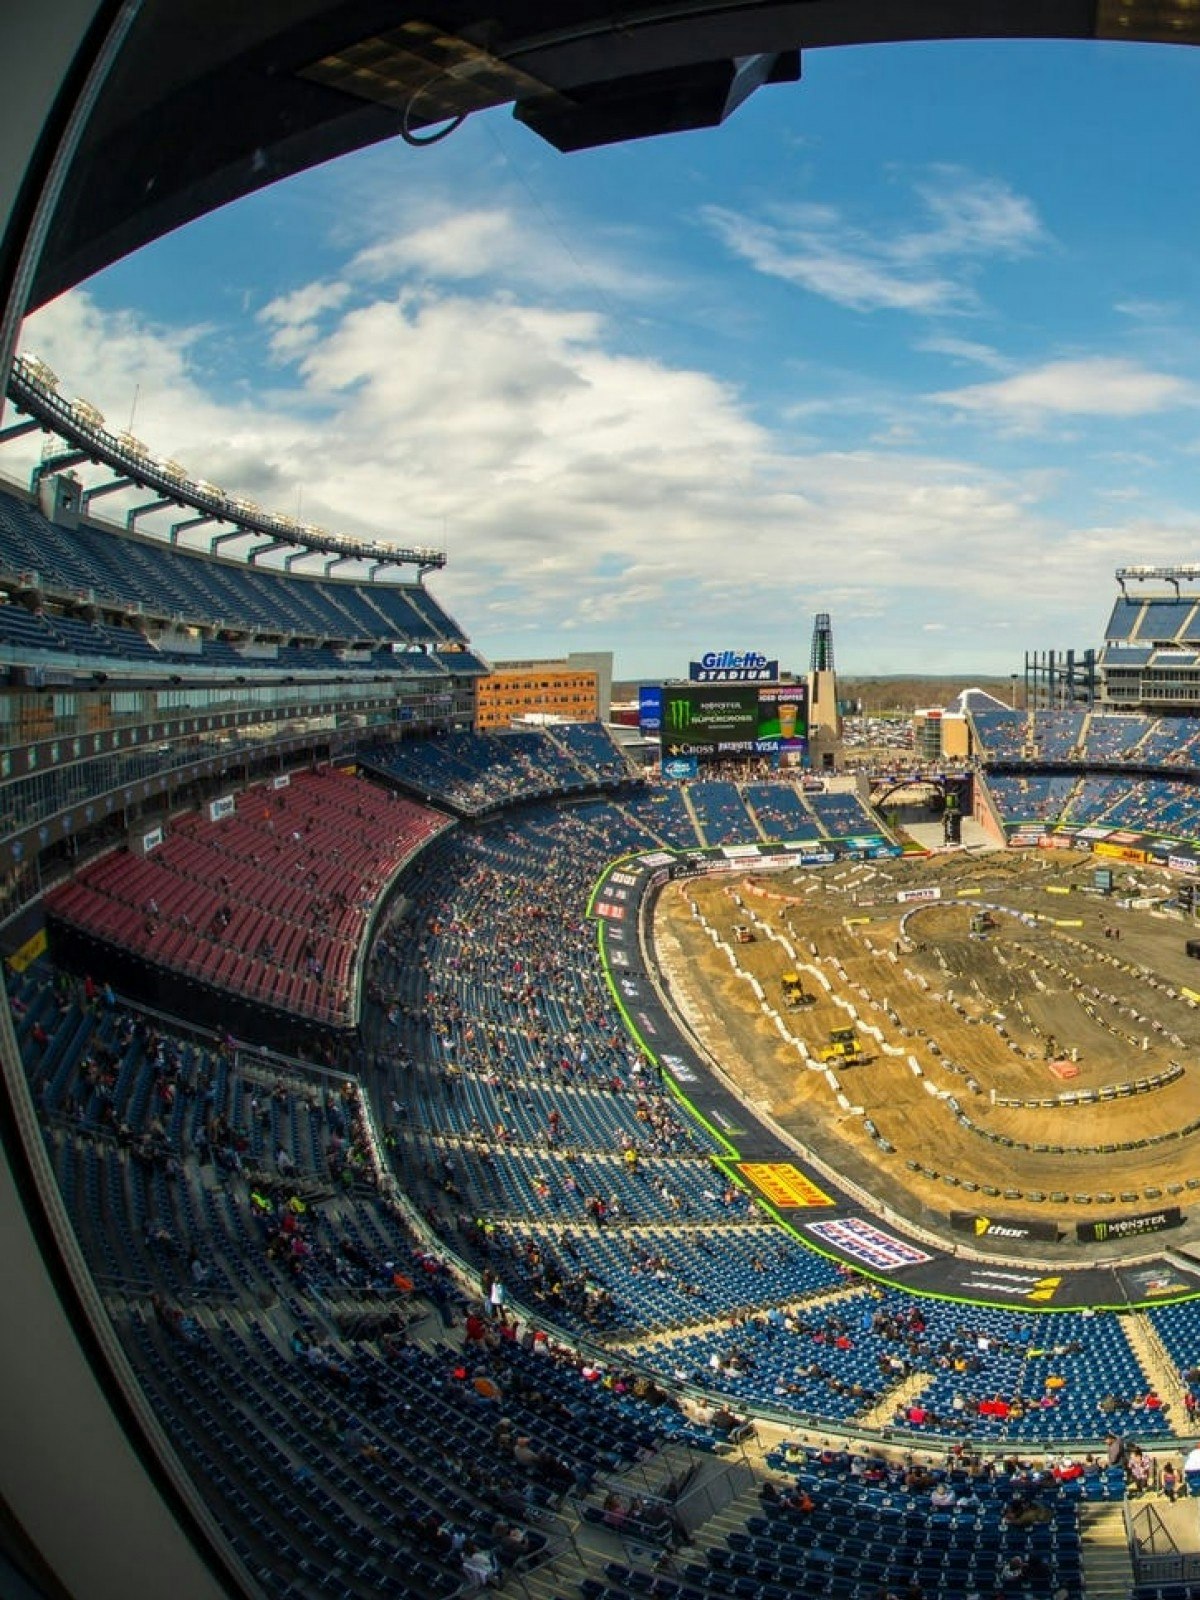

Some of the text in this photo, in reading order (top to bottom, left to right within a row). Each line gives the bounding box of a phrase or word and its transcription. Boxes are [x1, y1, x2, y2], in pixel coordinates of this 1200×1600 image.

[702, 651, 768, 668] Gillette
[698, 670, 771, 680] STADIUM
[1108, 1214, 1166, 1233] MONSTER
[987, 1225, 1029, 1238] thor
